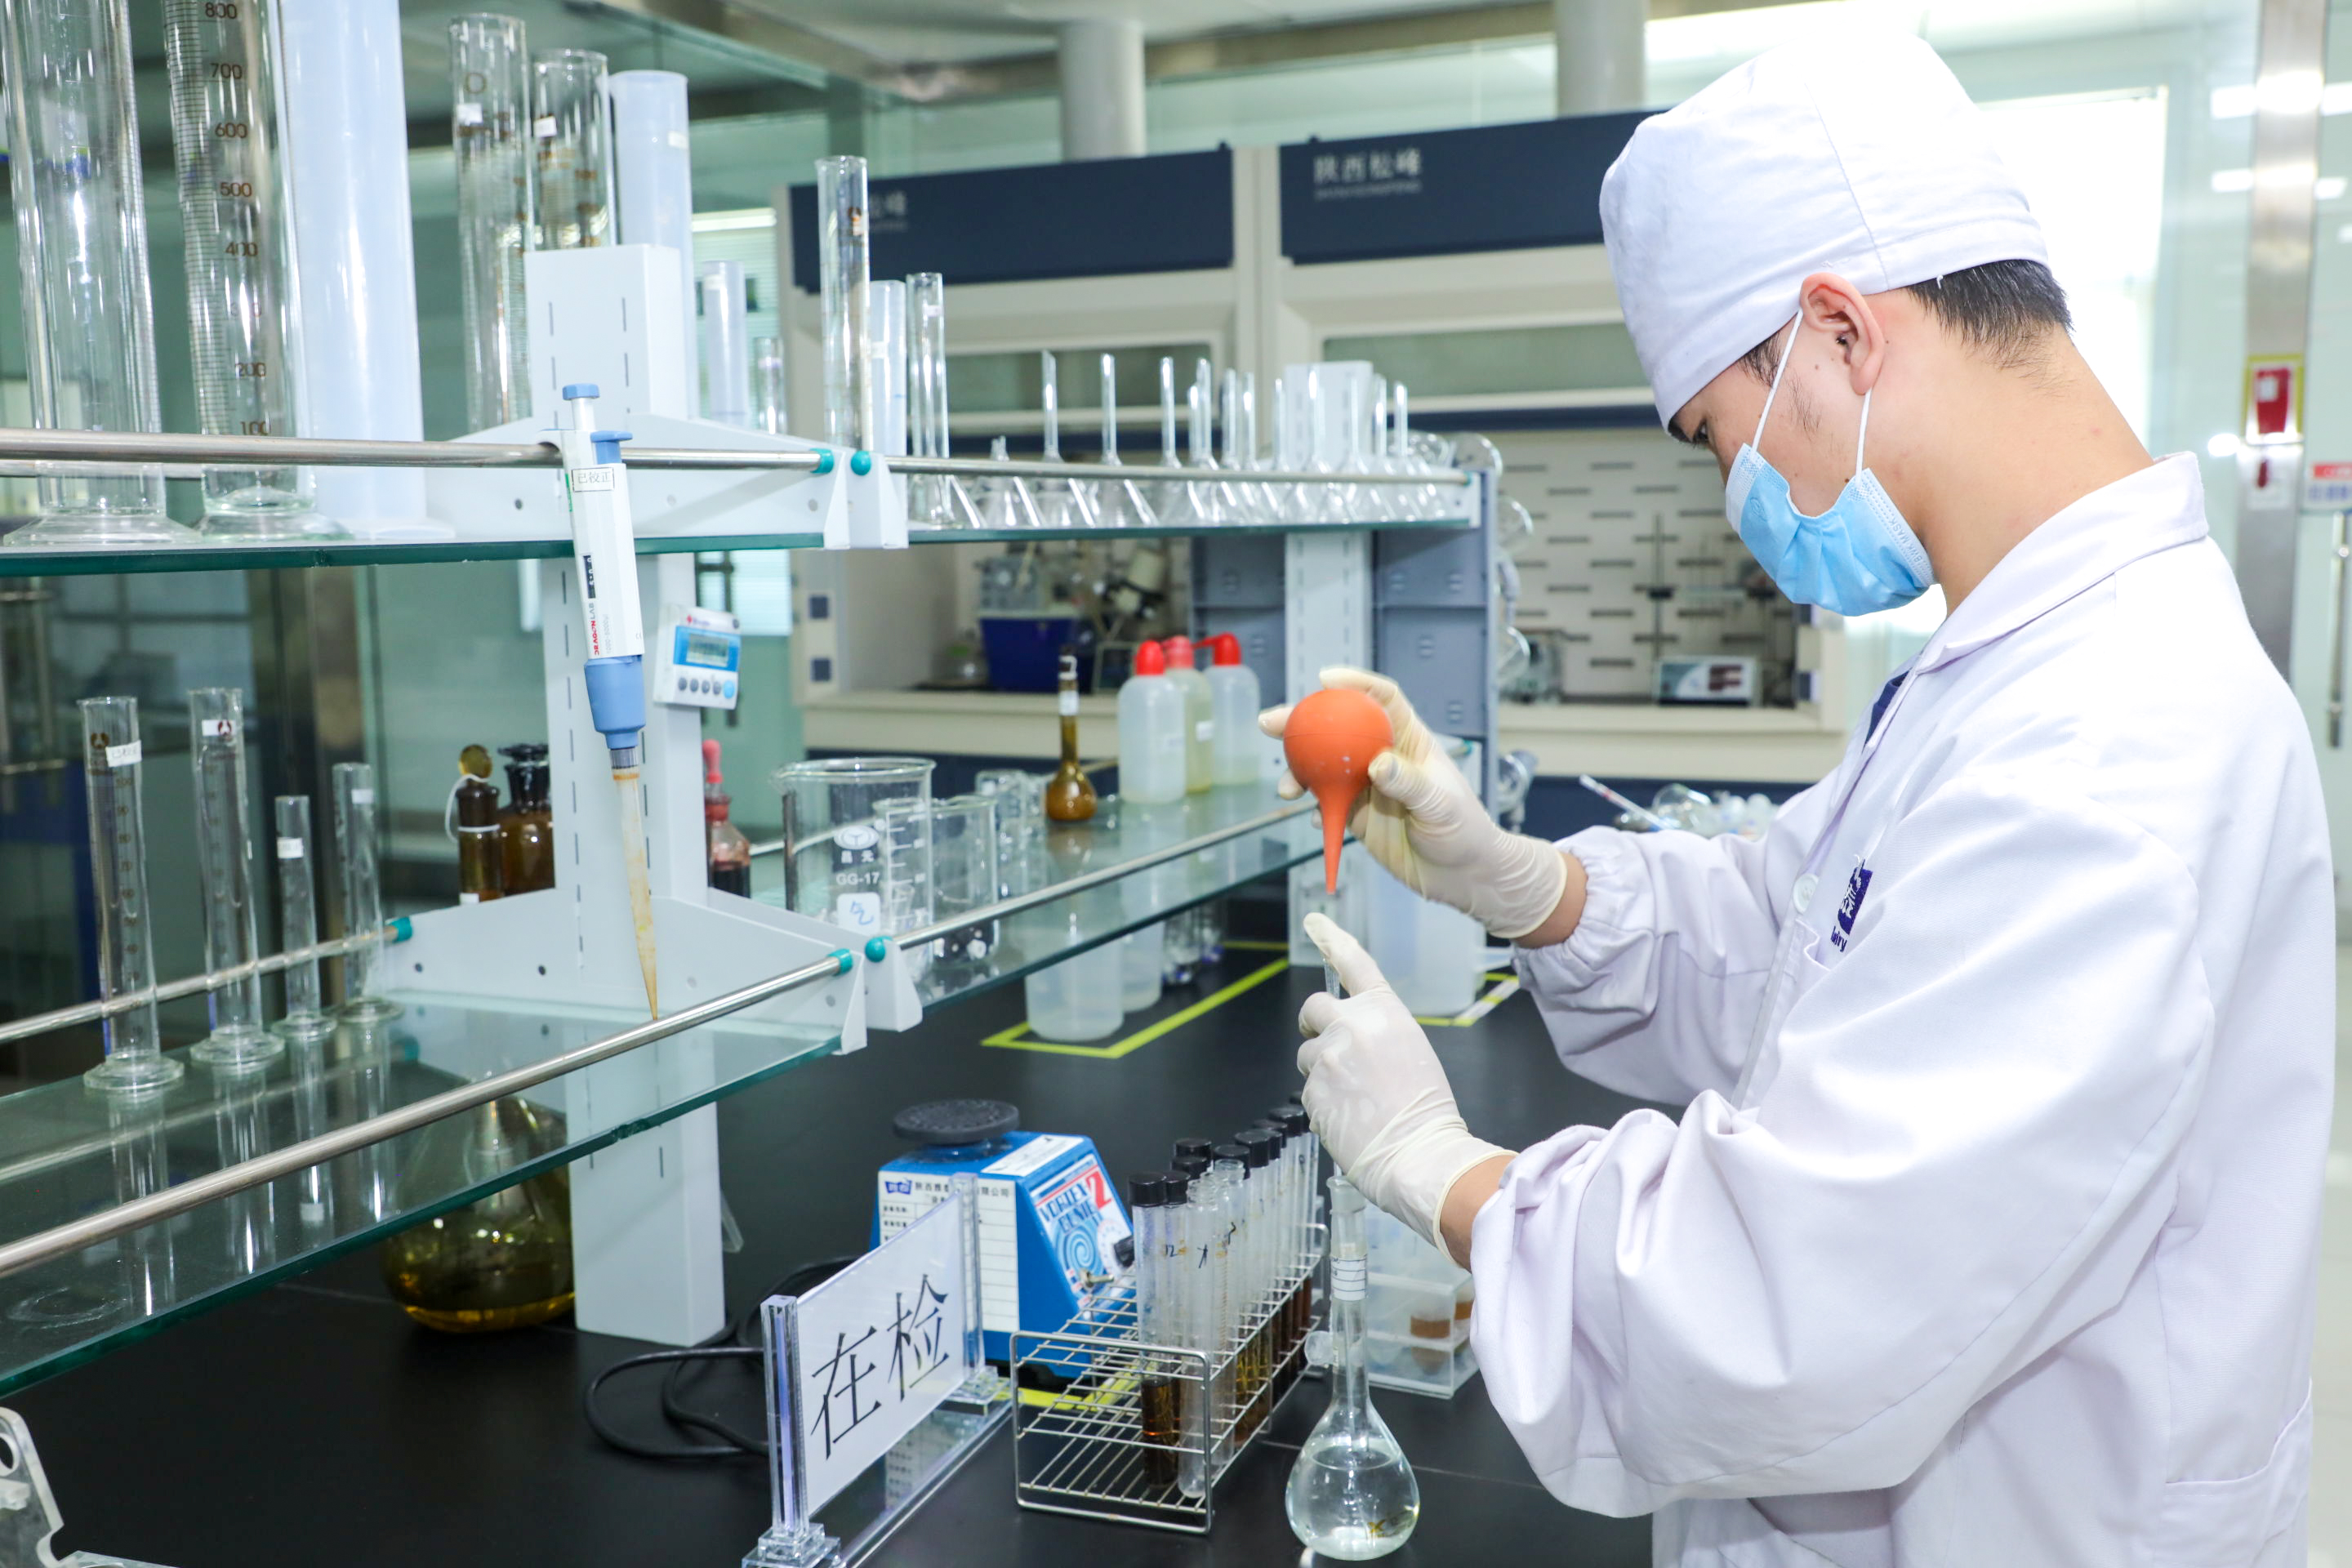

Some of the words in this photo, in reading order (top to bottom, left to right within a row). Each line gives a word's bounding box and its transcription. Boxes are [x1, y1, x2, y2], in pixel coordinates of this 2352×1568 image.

[205, 2, 238, 19] 800
[211, 63, 243, 79] 700
[215, 122, 249, 138] 600
[220, 182, 252, 197] 500
[225, 242, 259, 257] 400
[230, 302, 262, 318] 30
[236, 362, 267, 377] 200
[240, 421, 271, 436] 100
[836, 871, 880, 885] GG-17
[1085, 1170, 1113, 1209] 2
[810, 1273, 950, 1461] 在检
